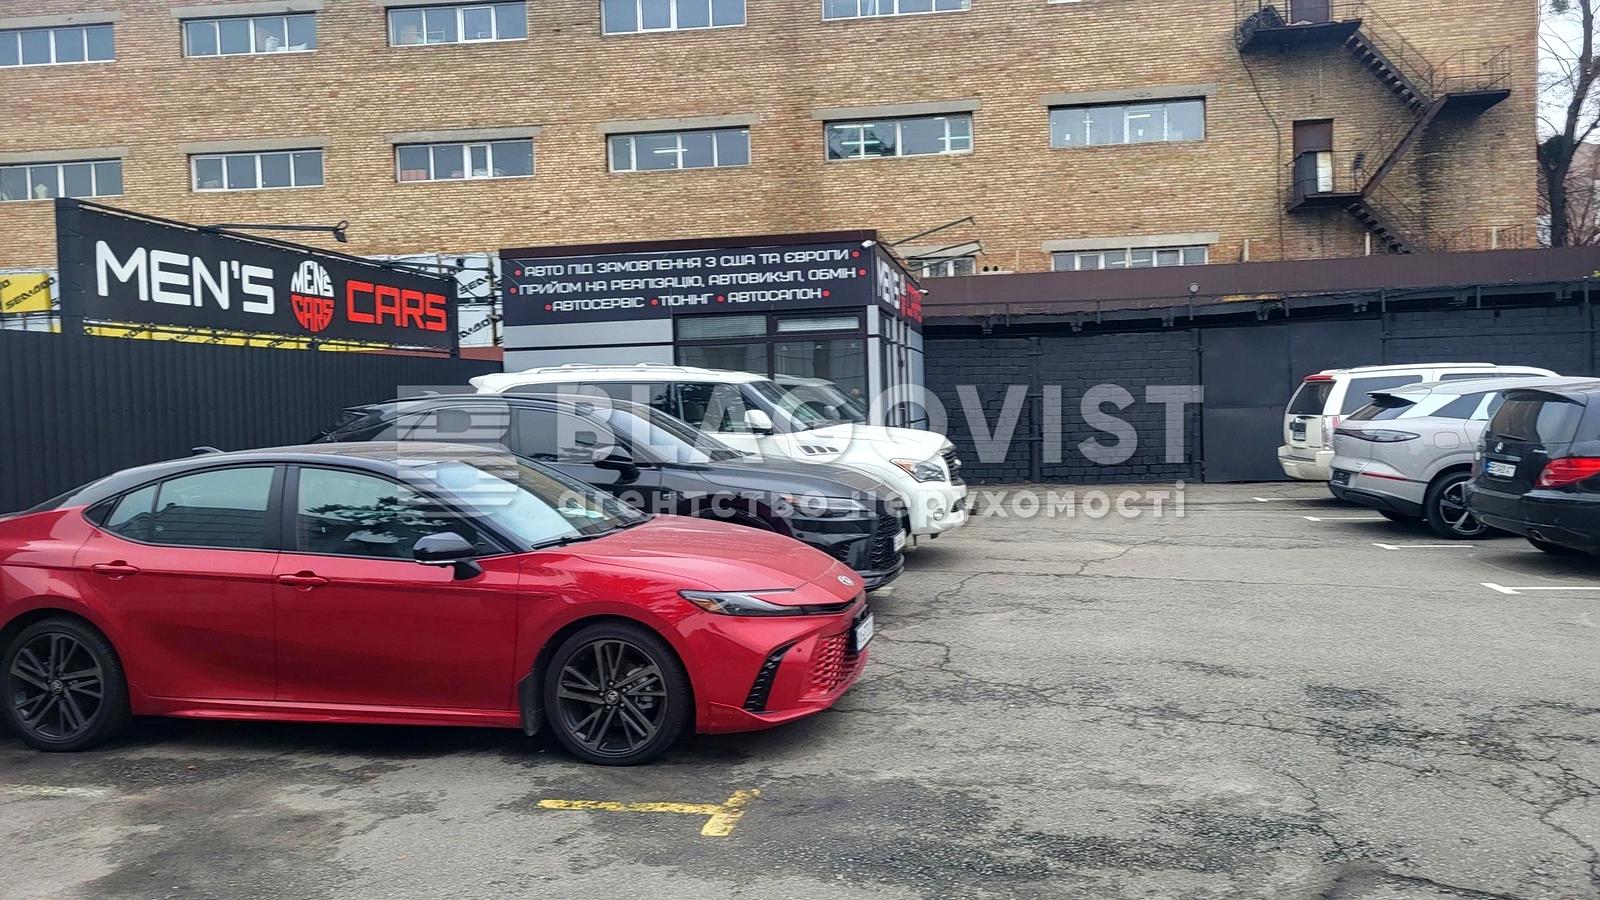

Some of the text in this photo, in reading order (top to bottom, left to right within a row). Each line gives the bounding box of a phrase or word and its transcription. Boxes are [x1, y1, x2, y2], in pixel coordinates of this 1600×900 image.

[524, 264, 565, 277] АВТО
[567, 263, 594, 275] ПІД
[597, 257, 702, 273] ЗАМОВЛЕННЯ
[720, 254, 756, 267] США
[759, 253, 781, 265] ТА
[784, 249, 850, 263] ЄВРОПИ
[95, 240, 448, 332] MEN'S CARS
[518, 280, 582, 295] ПРИЙОМ
[585, 281, 608, 292] НА
[808, 267, 857, 281] ОБМІН
[290, 294, 335, 332] CARS
[552, 288, 822, 312] АВТОСЕРВІС ТЮНІНГ АВТОСАЛОН
